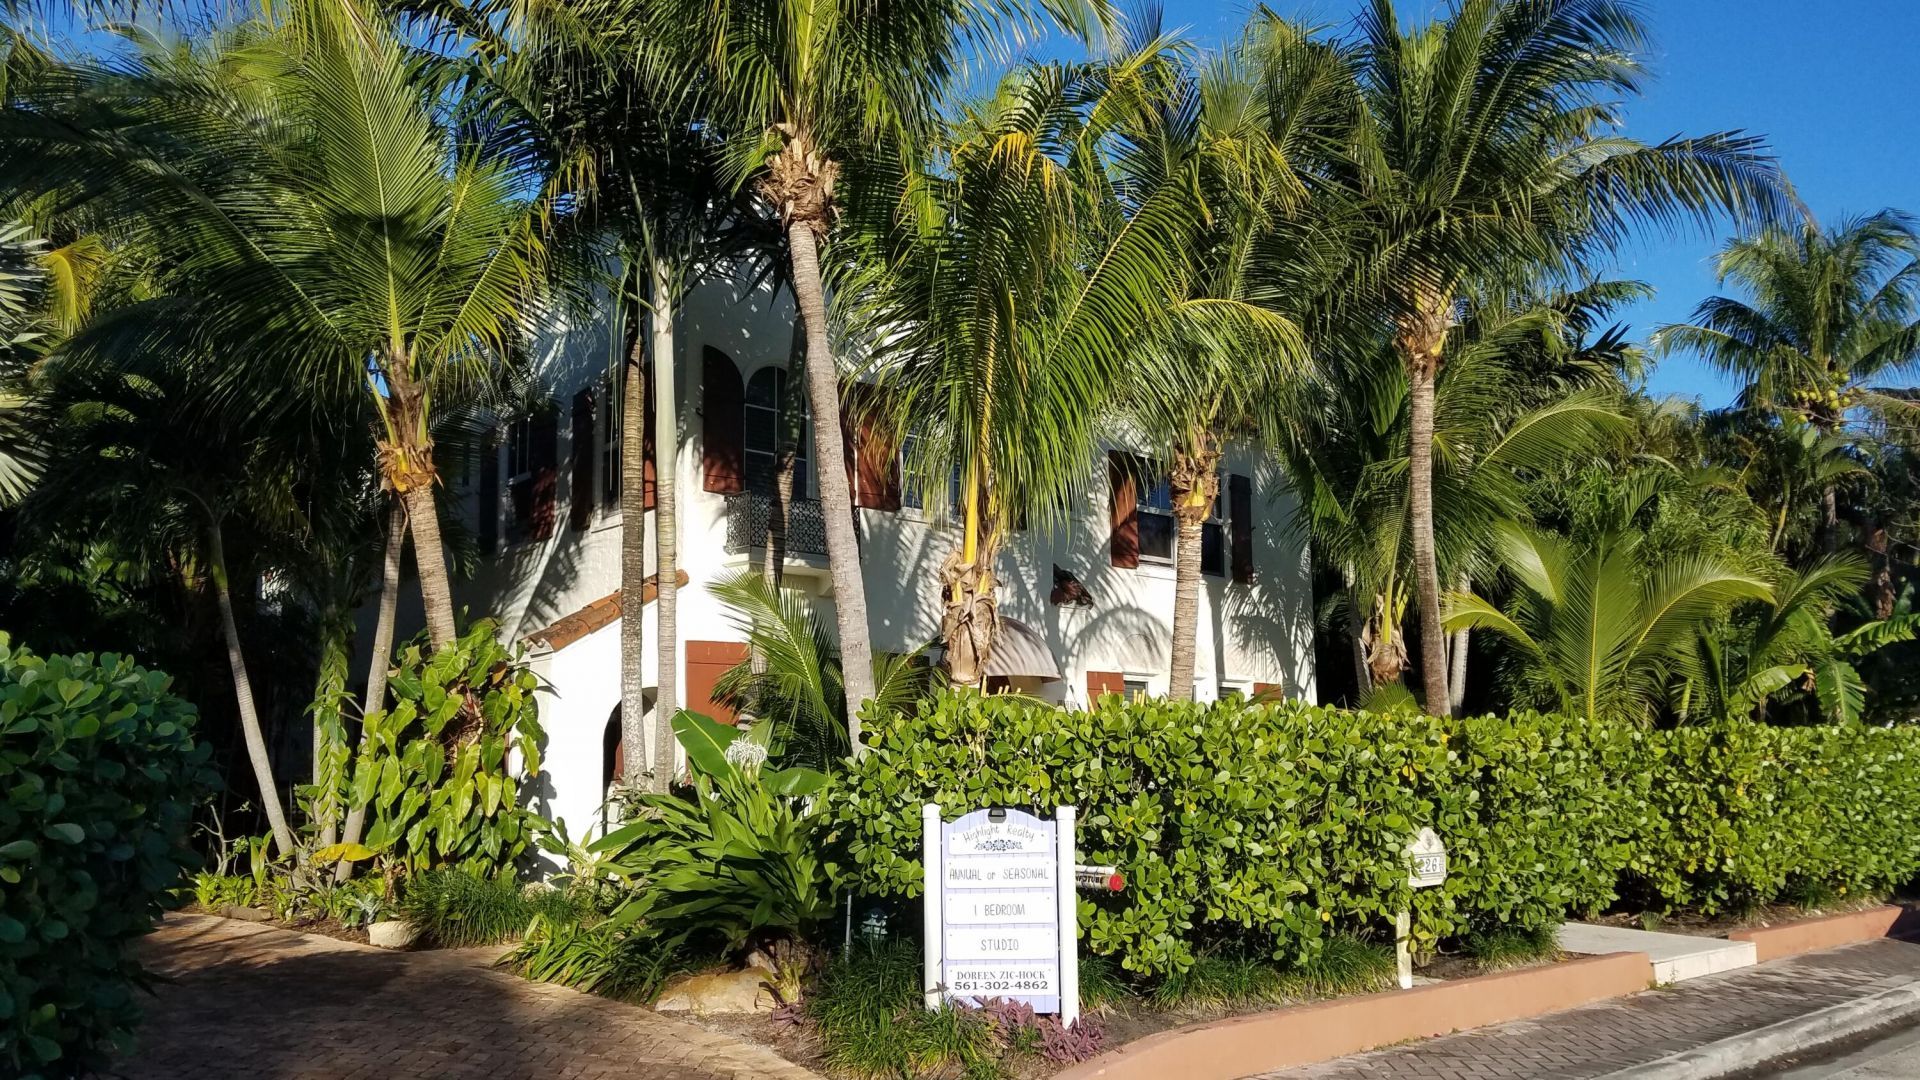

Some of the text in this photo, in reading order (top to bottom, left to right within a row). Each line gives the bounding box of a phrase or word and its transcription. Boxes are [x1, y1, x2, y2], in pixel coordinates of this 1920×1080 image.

[963, 824, 1034, 842] Highlight Realty
[950, 867, 1048, 880] ANNUAL or SEASONAL
[984, 904, 1025, 916] BEDROOM
[981, 938, 1019, 951] STUDIO
[957, 970, 1045, 980] DOREEN ZIC-HOCK
[954, 980, 1048, 990] 561-302-4862
